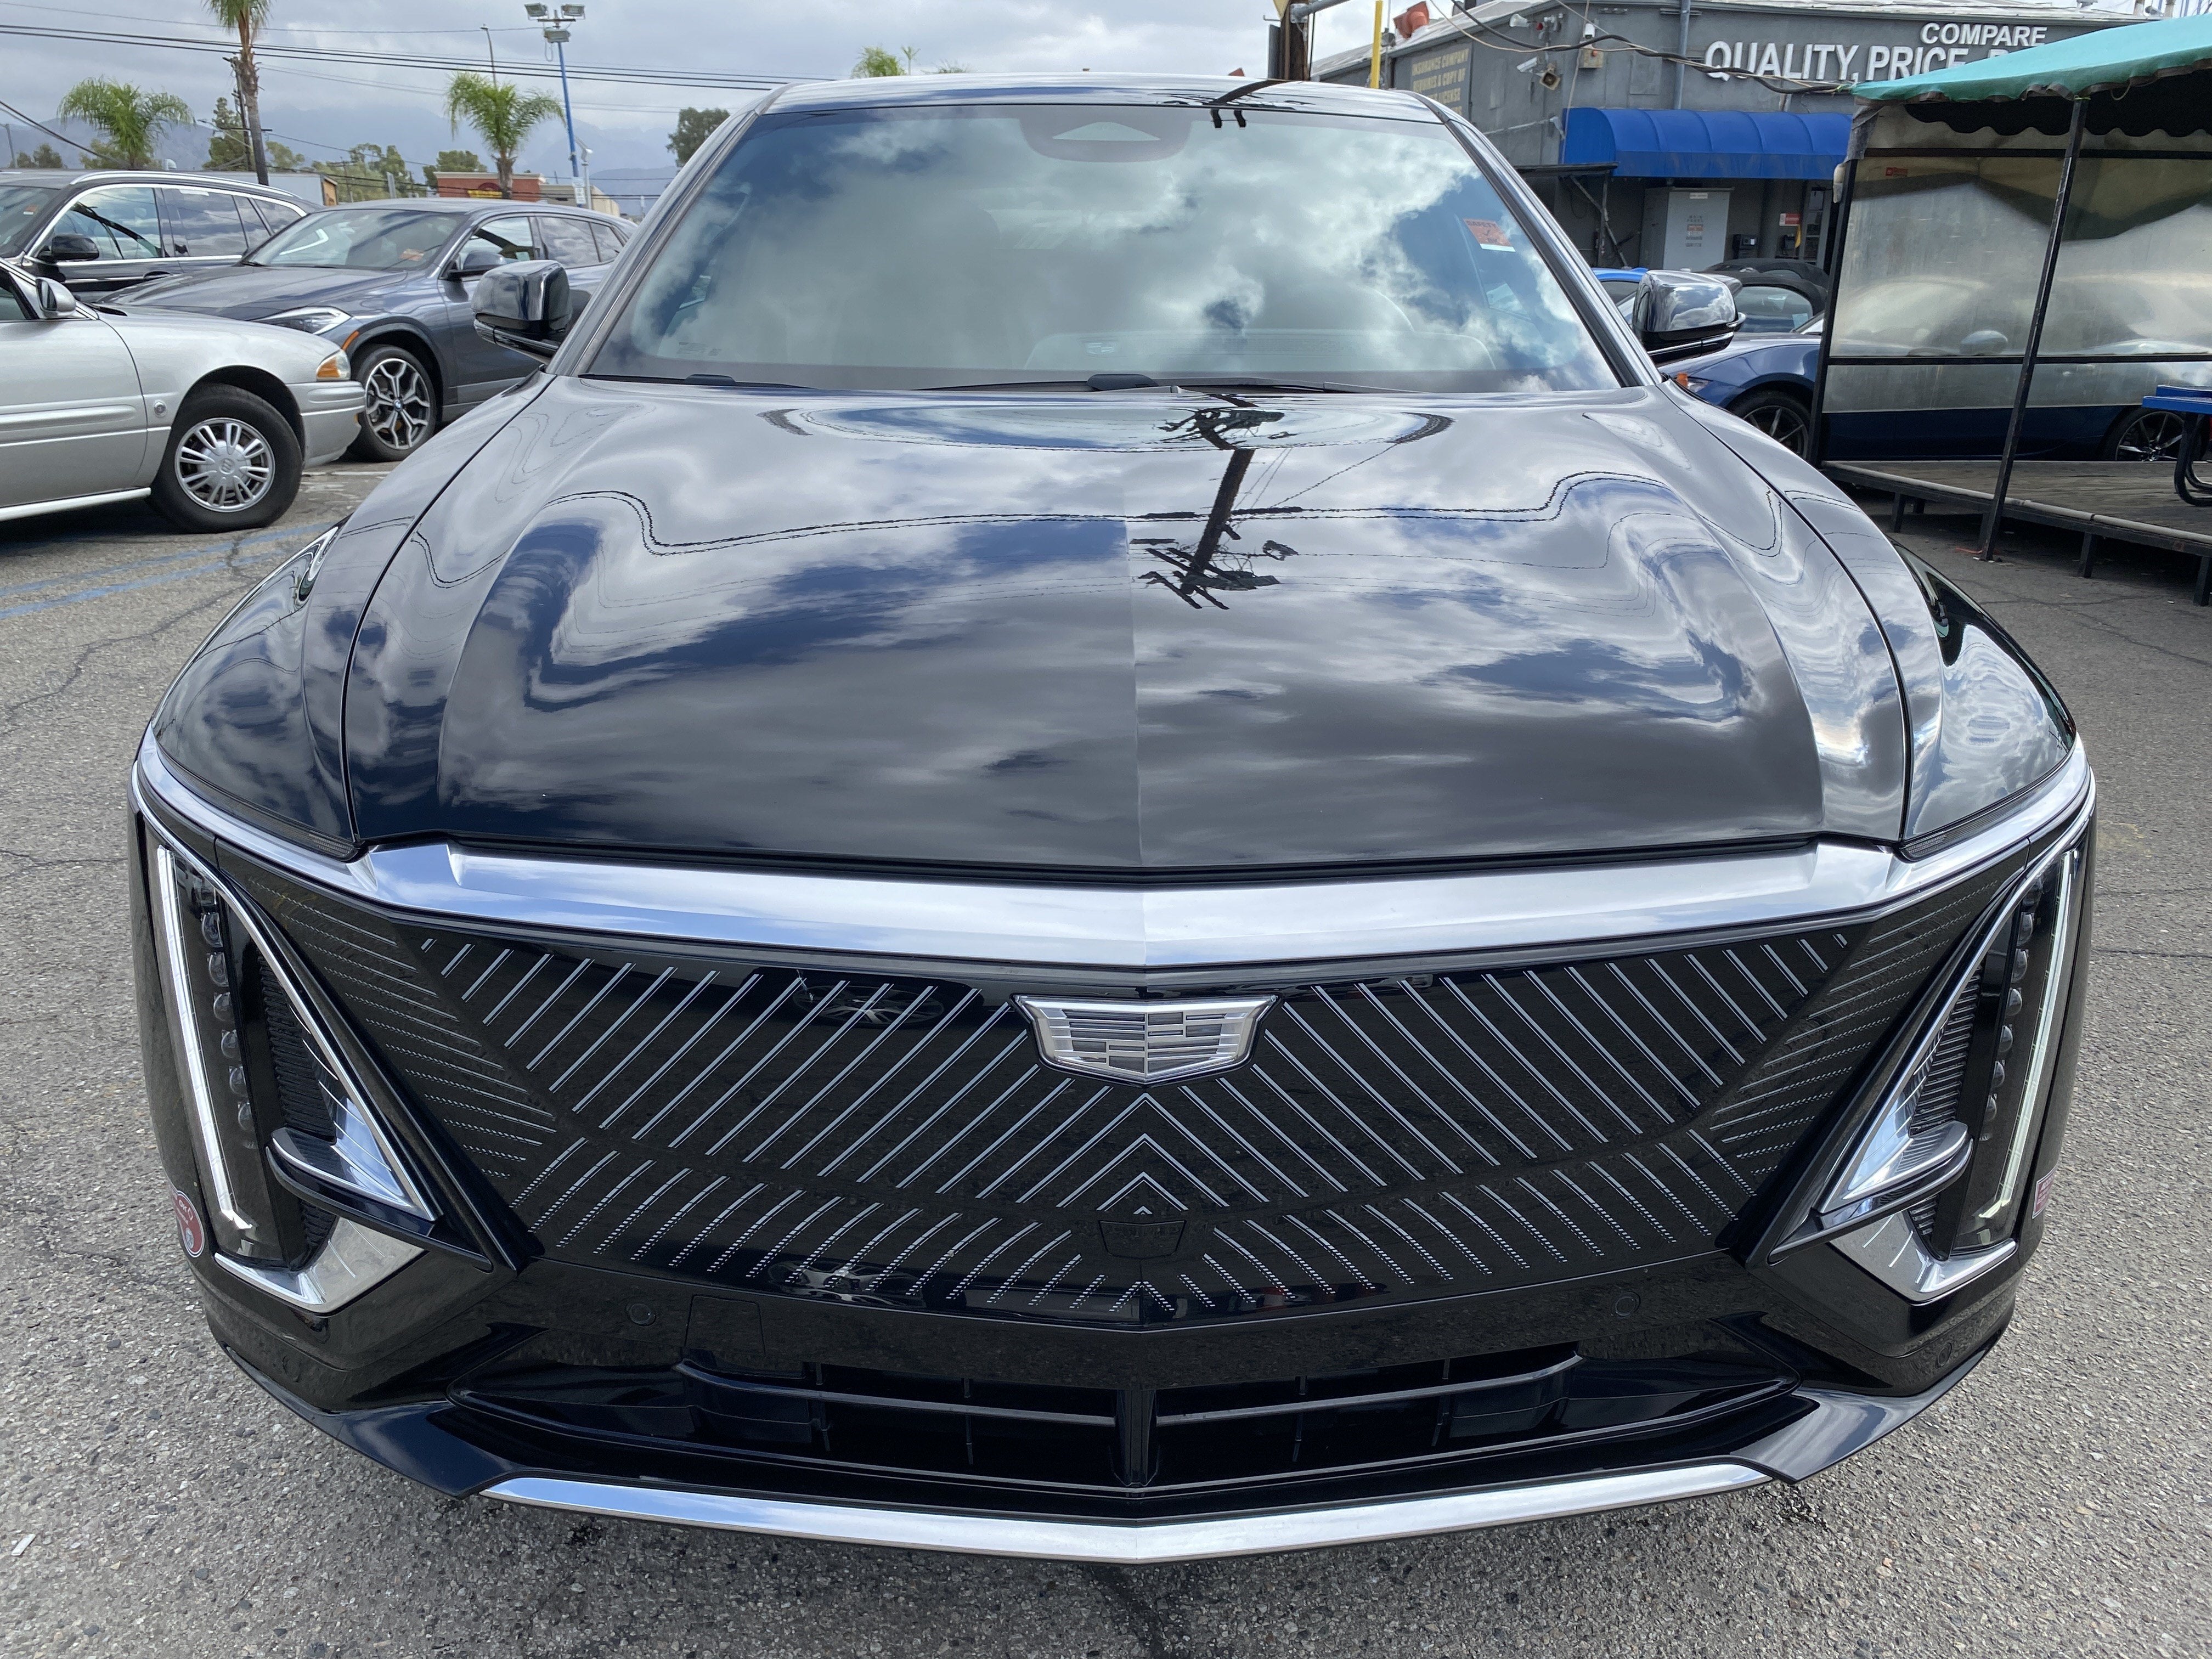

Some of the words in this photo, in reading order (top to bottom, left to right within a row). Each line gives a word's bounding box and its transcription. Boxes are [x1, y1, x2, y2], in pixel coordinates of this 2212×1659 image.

[1921, 22, 2047, 47] COMPARE
[1441, 48, 1469, 69] COMPANY
[1705, 41, 1860, 87] QUALITY,
[179, 1199, 187, 1213] OK
